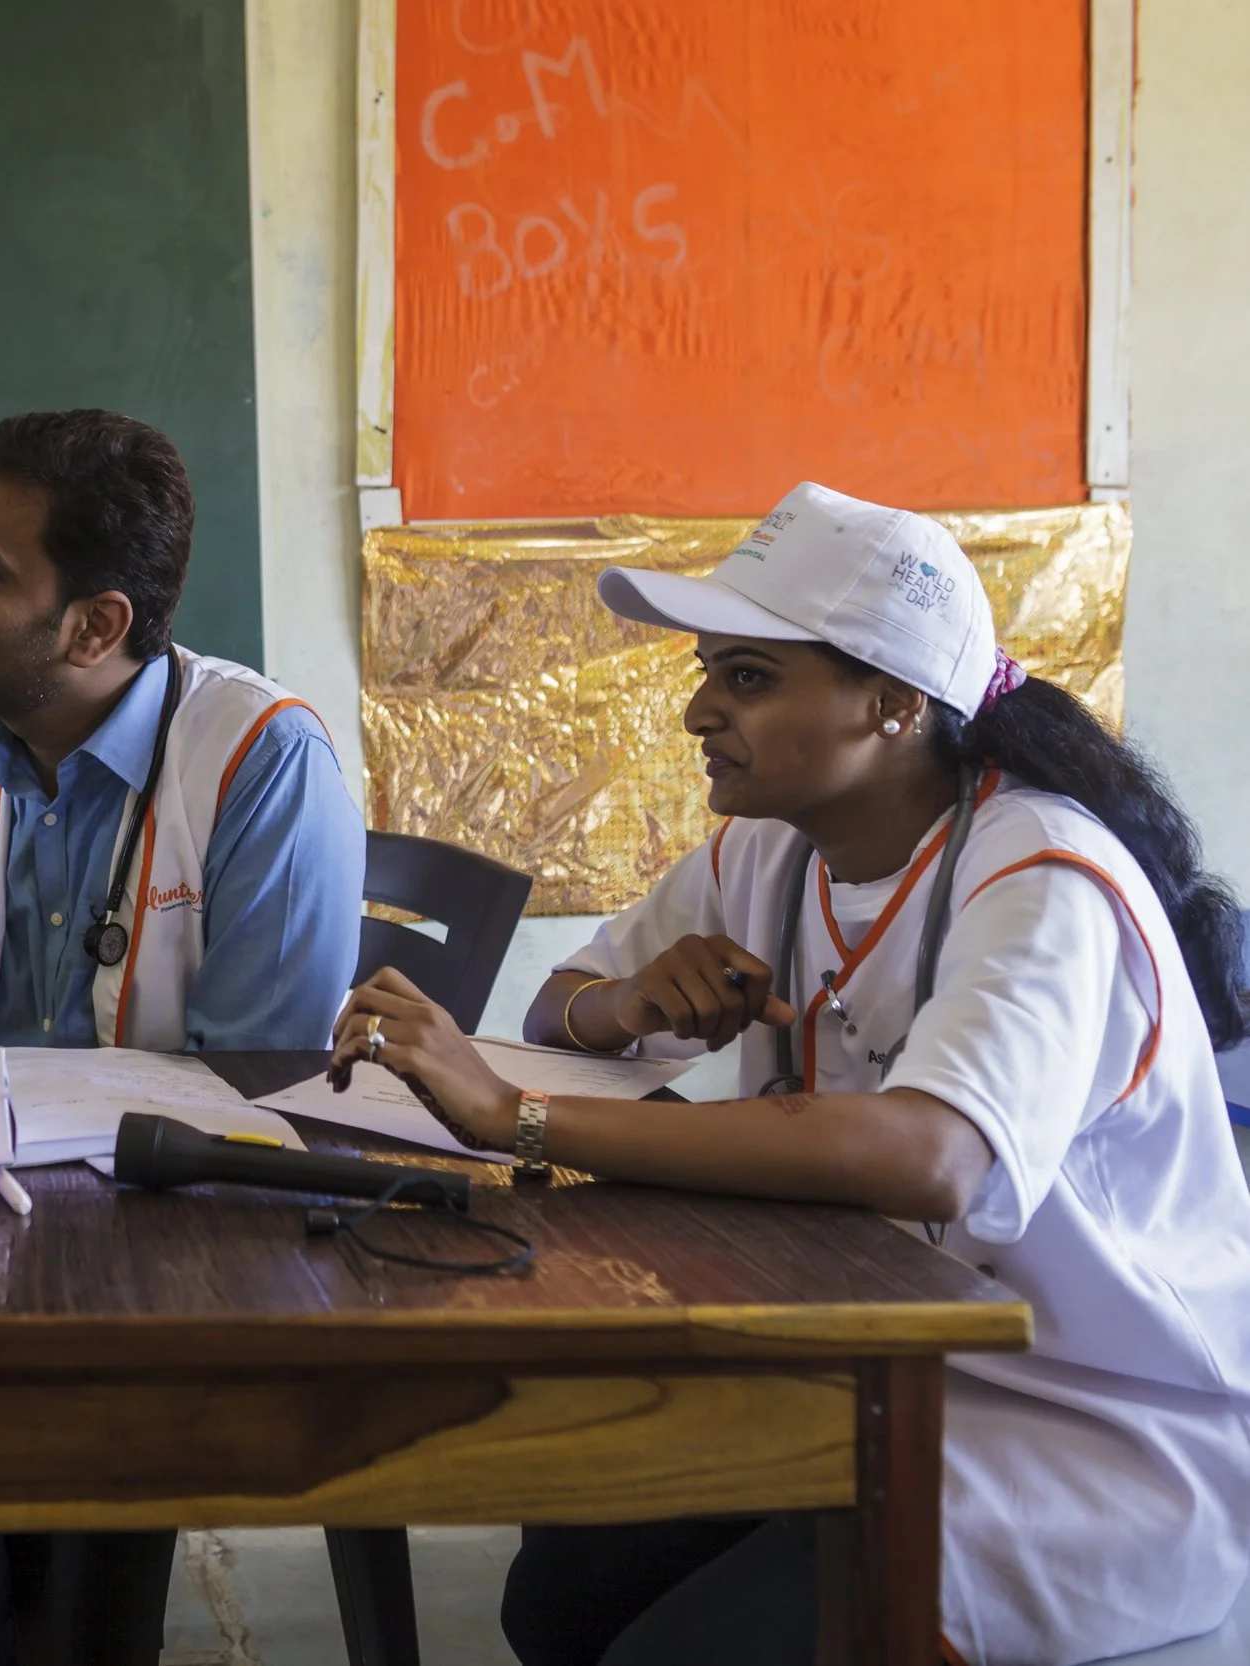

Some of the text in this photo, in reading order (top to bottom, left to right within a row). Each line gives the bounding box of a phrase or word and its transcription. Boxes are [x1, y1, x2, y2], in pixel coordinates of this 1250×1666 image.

[445, 182, 688, 310] BOYS
[891, 564, 950, 603] HEALTH
[900, 551, 955, 593] WRLD
[905, 587, 935, 613] DAY
[868, 1049, 886, 1065] As
